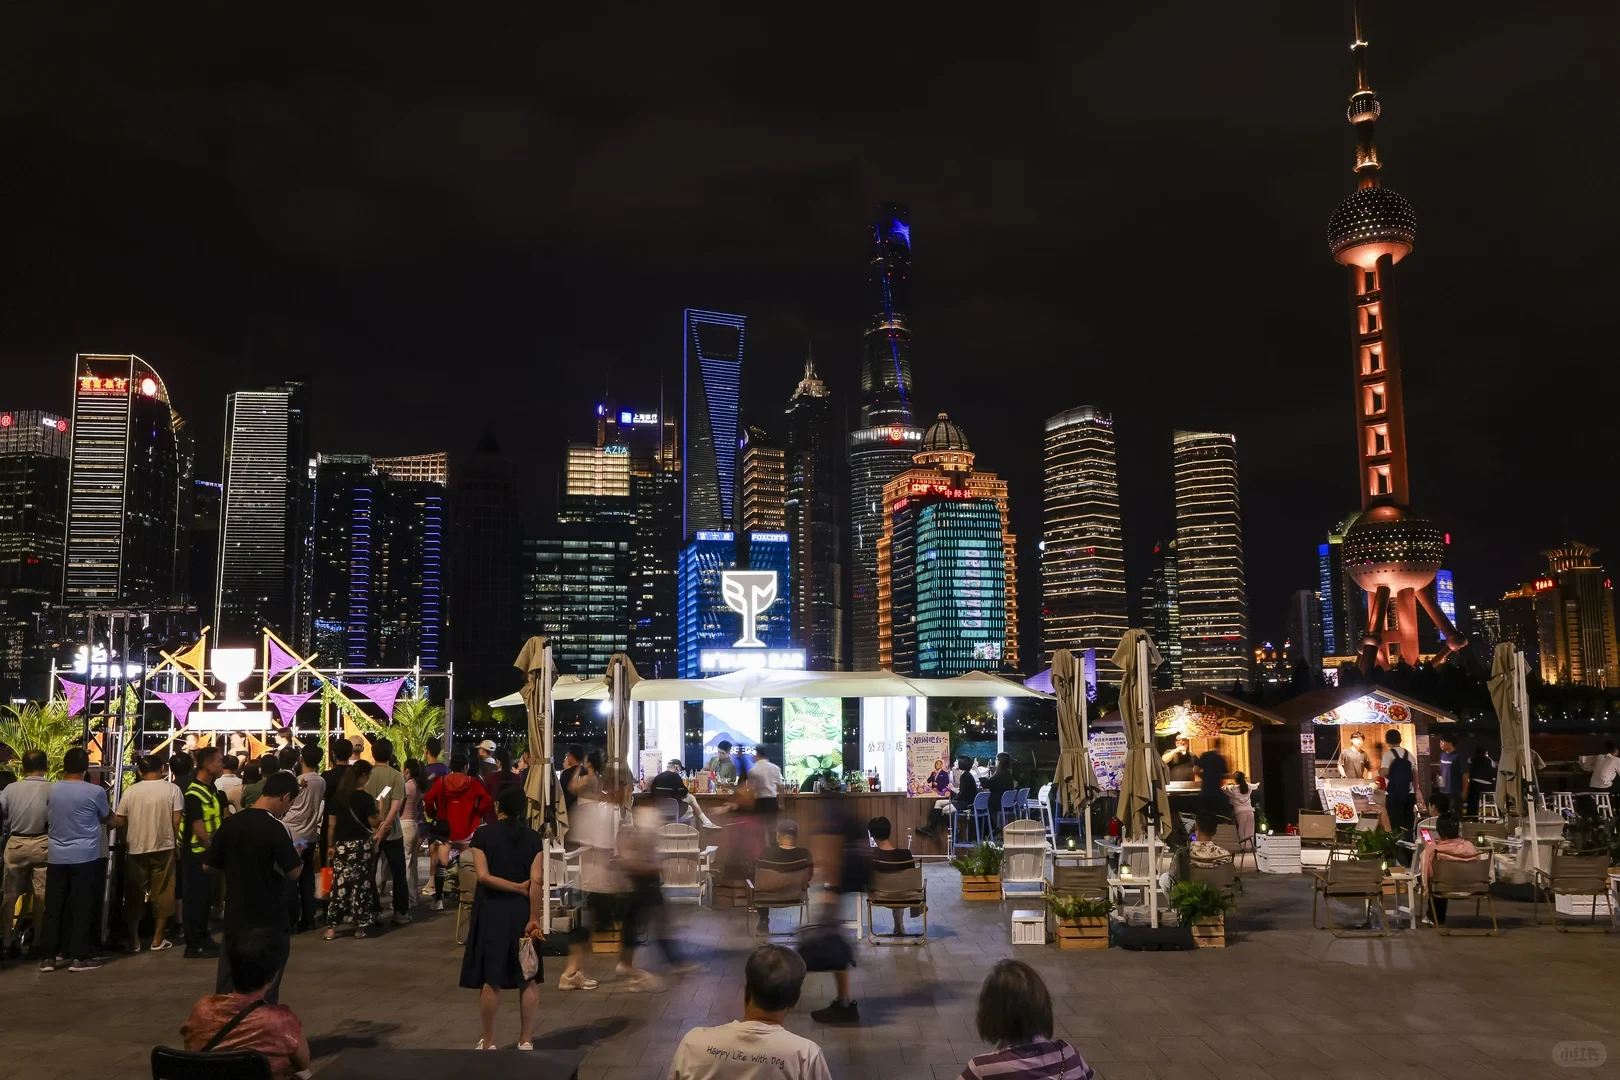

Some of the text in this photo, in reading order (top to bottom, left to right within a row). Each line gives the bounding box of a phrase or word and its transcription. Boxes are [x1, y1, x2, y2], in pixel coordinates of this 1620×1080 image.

[81, 379, 126, 389] 招商银行
[43, 417, 57, 428] ICBC
[604, 445, 628, 455] AZIA
[944, 489, 972, 499] 中经社
[768, 652, 804, 668] BAR
[914, 736, 942, 745] 胡闹吧台
[868, 740, 903, 753] 公路店
[706, 1045, 731, 1061] Happy
[732, 1050, 748, 1062] Life
[771, 1056, 785, 1070] Dog
